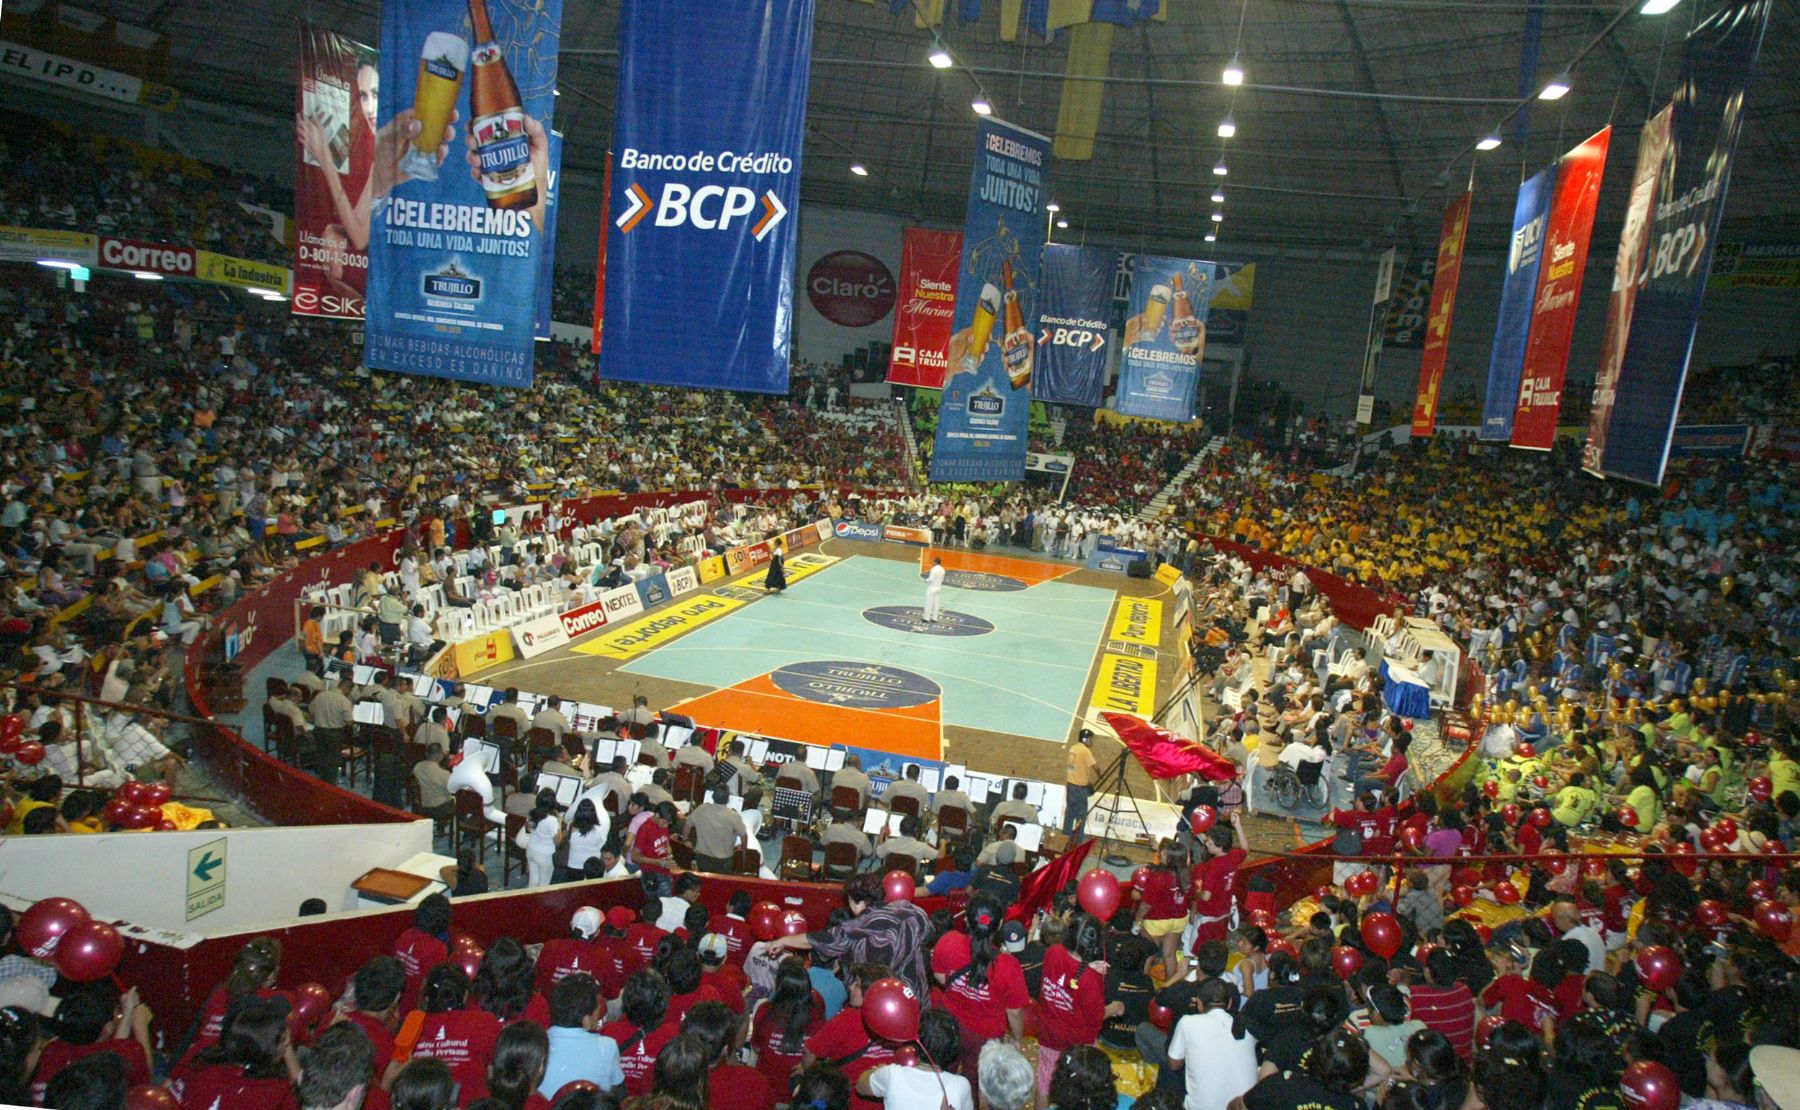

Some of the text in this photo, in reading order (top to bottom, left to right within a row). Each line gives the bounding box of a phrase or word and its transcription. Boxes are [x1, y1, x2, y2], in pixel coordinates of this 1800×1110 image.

[2, 48, 32, 70] EL
[481, 143, 529, 168] TRUJILLO
[985, 133, 1042, 166] ¡CELEBREMOS
[621, 148, 792, 174] Banco de Crédito
[986, 155, 1005, 175] TODA
[980, 174, 1039, 214] JUNTOS!
[655, 183, 756, 230] BCP
[386, 197, 531, 237] ¡CELEBREMOS
[386, 229, 530, 257] TODA UNA VIDA JUNTOS!
[1652, 223, 1696, 278] BCP
[103, 239, 192, 272] Correo
[223, 262, 236, 277] La
[239, 264, 282, 286] Industria
[432, 280, 473, 294] TRUJILLO
[813, 276, 879, 298] Claro
[915, 289, 954, 301] Nuestra
[920, 279, 951, 291] Siente
[1040, 315, 1107, 330] Banco de Crédito
[408, 337, 450, 356] BEBIDAS
[1053, 328, 1093, 347] BCP
[393, 352, 442, 369] EXCESO
[451, 360, 465, 372] ES
[919, 349, 943, 359] CAJA
[1128, 346, 1196, 366] ¡CELEBREMOS
[676, 576, 689, 591] BCP
[605, 594, 638, 613] NEXTEL
[563, 609, 604, 635] Correo
[828, 669, 903, 684] TRUJILLO
[1109, 658, 1144, 698] LIBERTAD
[809, 682, 888, 699] TRUJILLO
[188, 893, 223, 912] SALIDA
